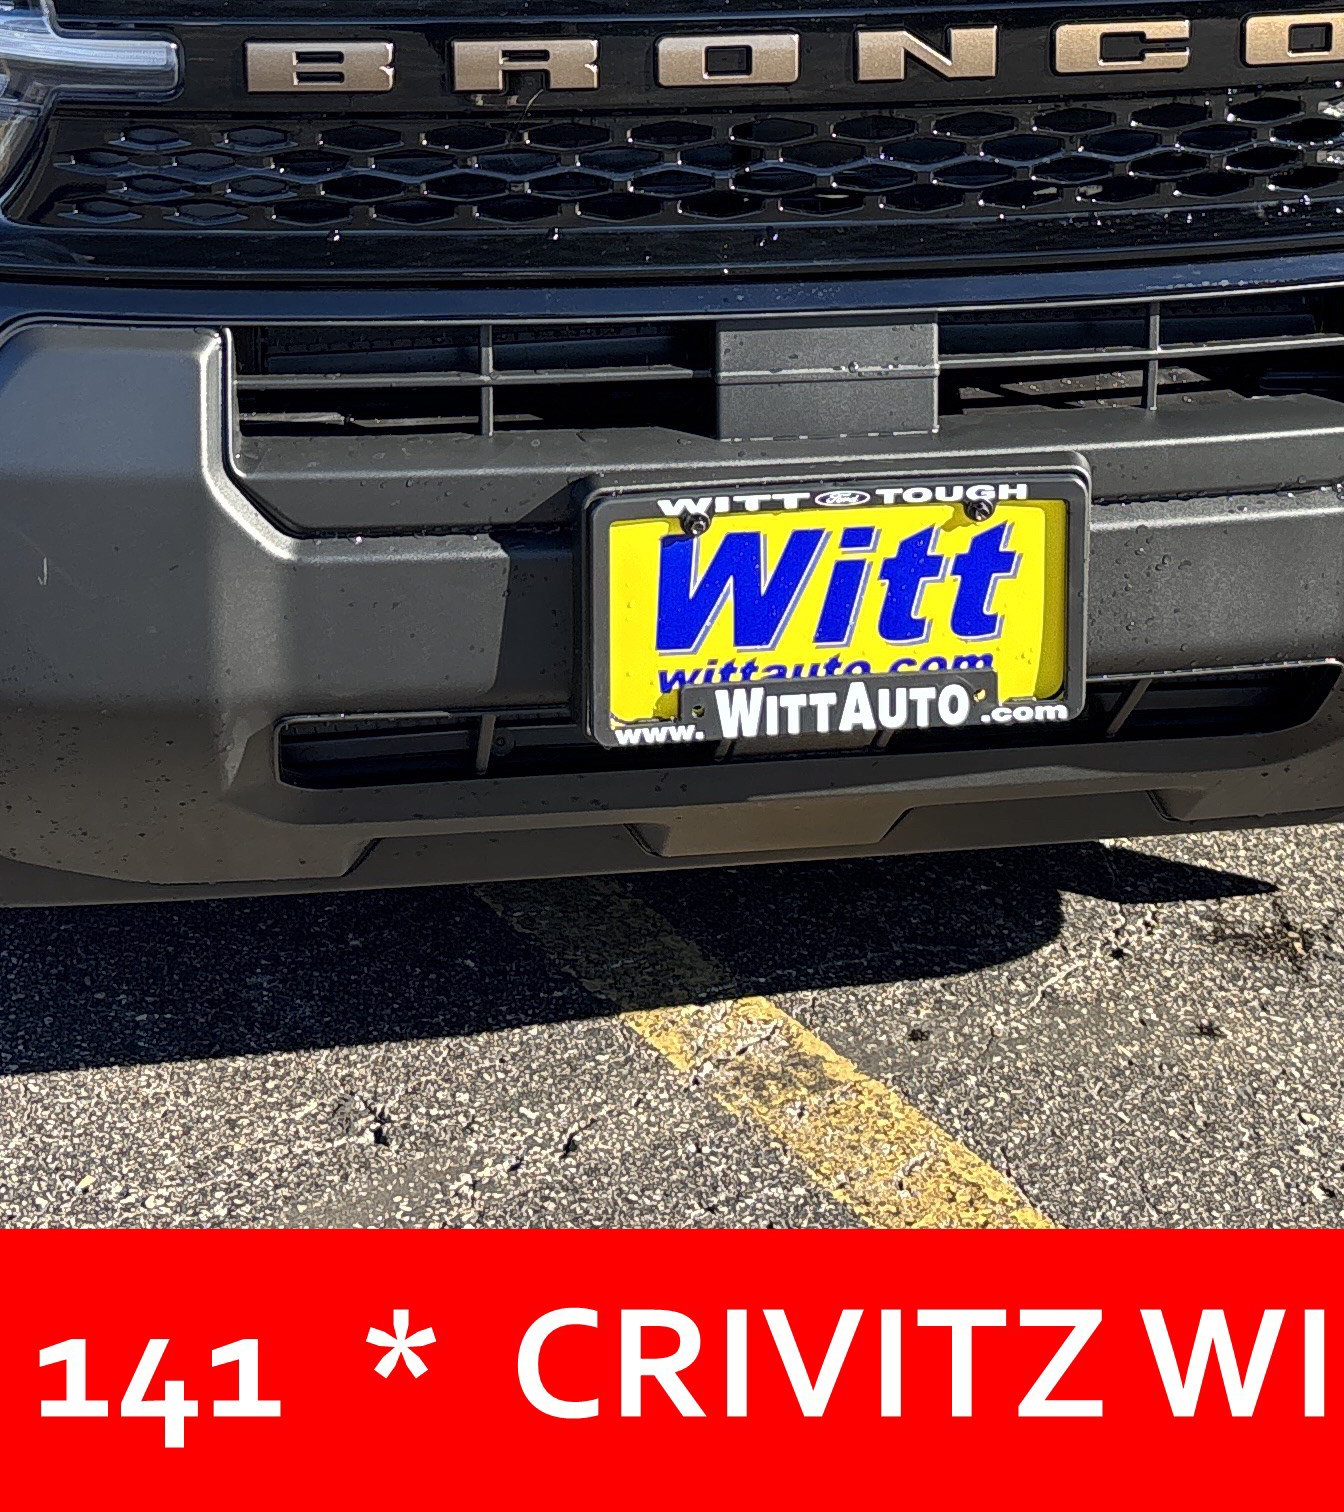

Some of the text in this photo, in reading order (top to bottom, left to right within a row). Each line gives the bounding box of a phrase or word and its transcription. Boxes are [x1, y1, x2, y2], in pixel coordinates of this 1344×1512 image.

[657, 492, 810, 516] WITT
[875, 483, 1028, 504] TOUGH
[655, 520, 1023, 657] Witt
[658, 652, 994, 694] wittautocom
